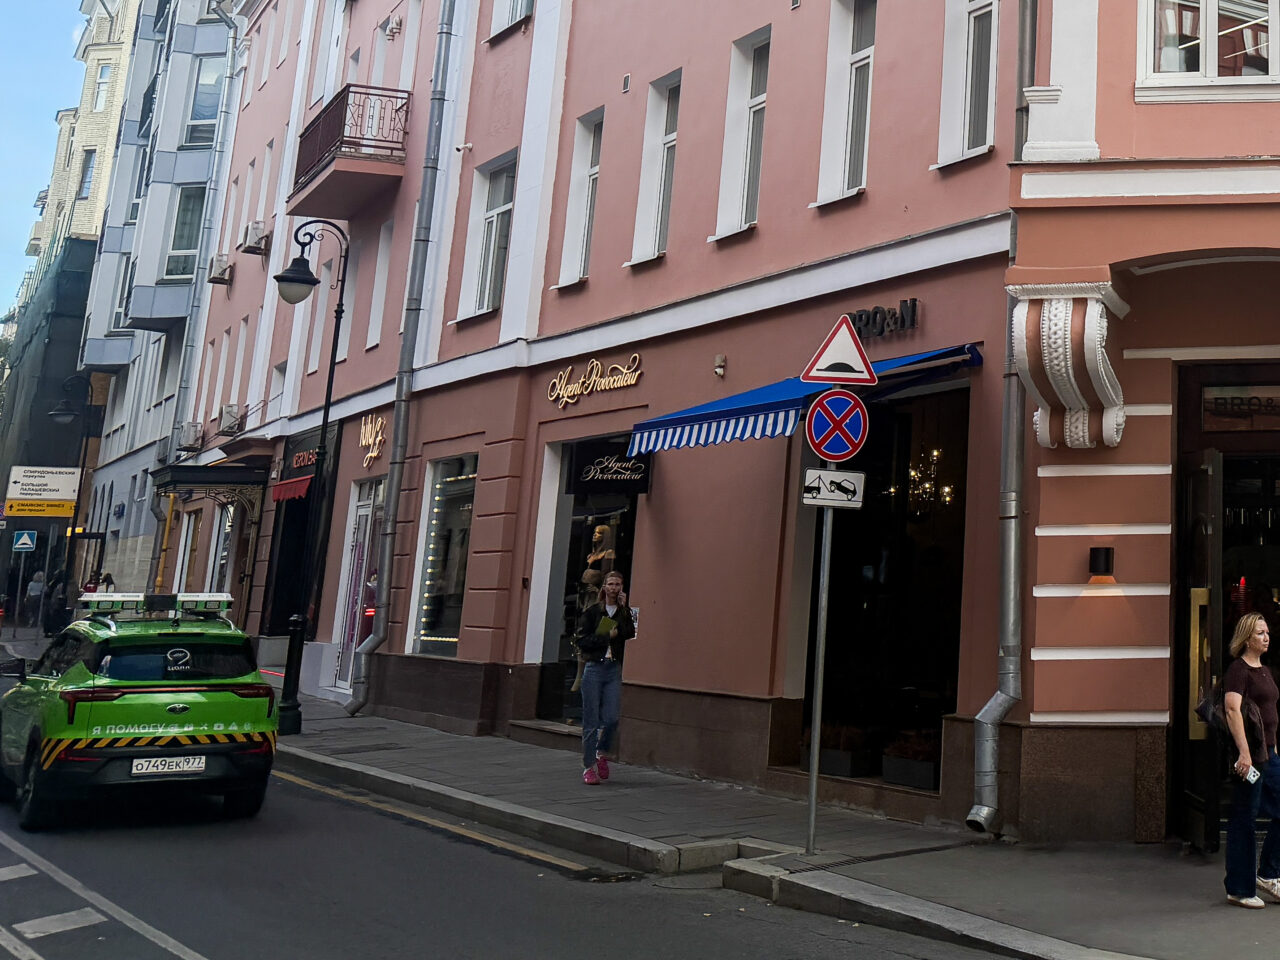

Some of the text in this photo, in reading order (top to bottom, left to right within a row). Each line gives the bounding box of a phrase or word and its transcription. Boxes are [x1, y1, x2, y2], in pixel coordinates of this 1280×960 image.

[547, 353, 642, 409] Agent Provocateur
[594, 454, 637, 473] Agent
[92, 723, 166, 735] Я ПОМОГУ
